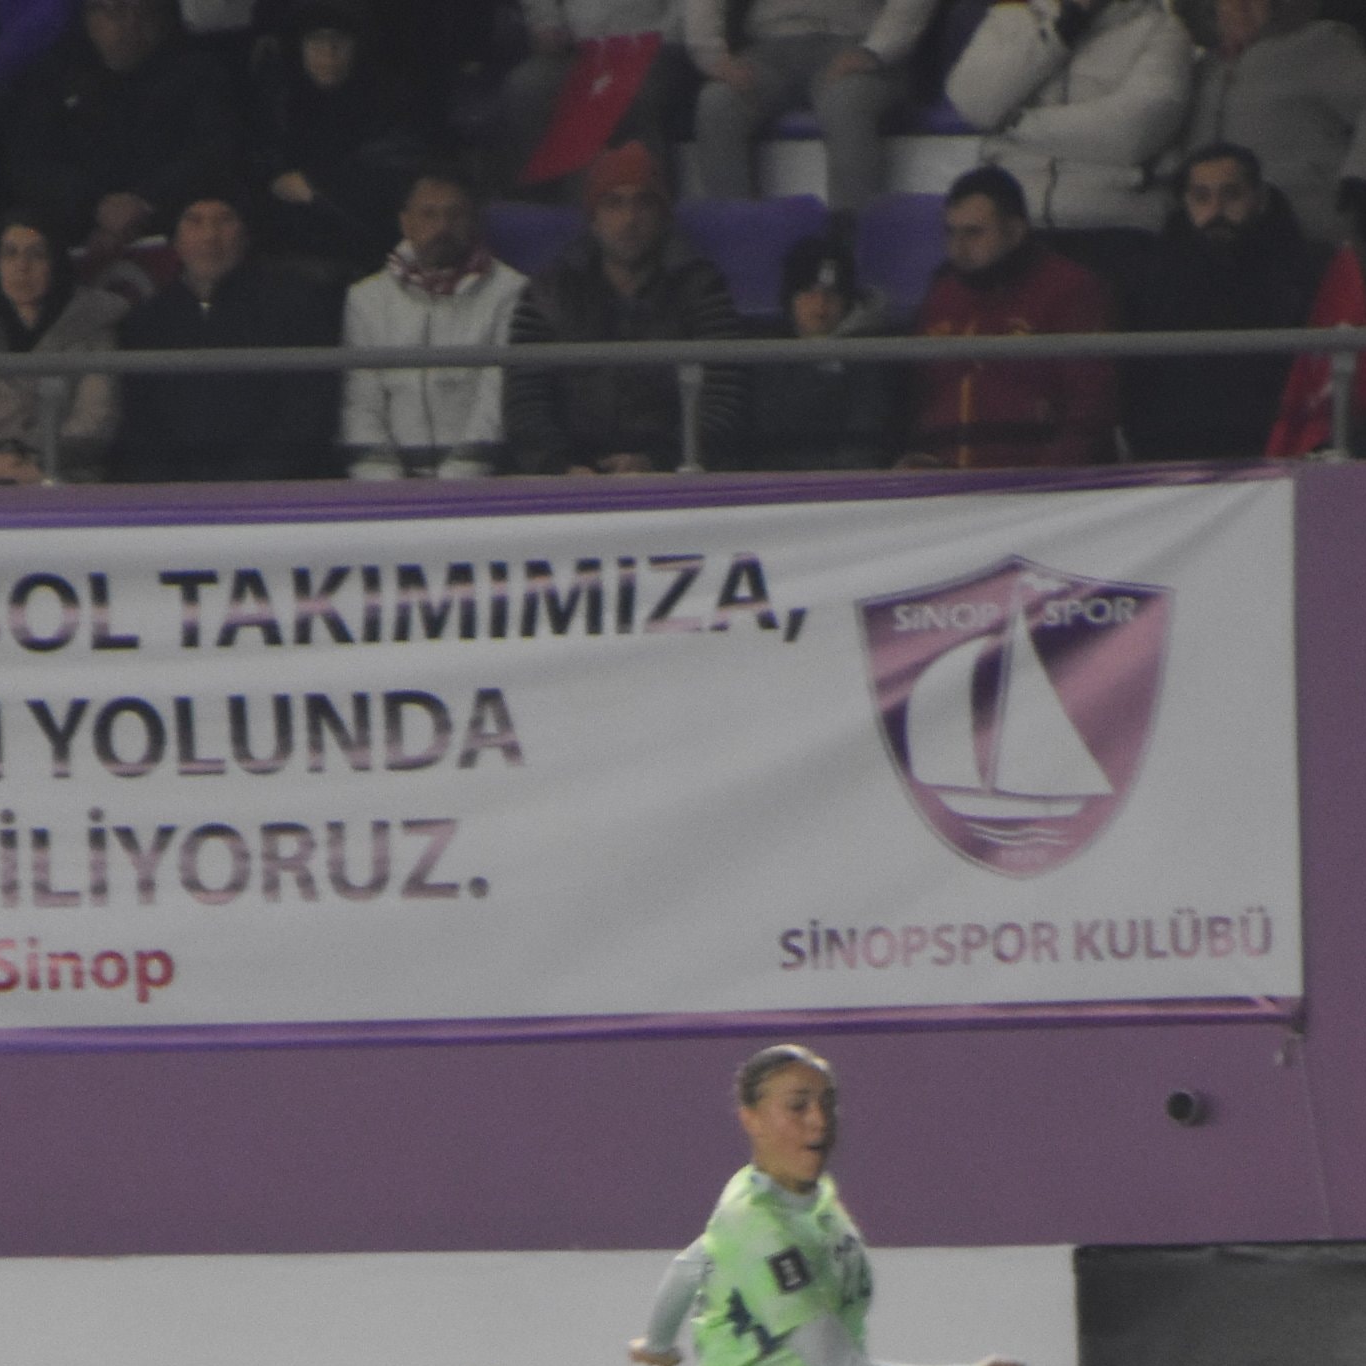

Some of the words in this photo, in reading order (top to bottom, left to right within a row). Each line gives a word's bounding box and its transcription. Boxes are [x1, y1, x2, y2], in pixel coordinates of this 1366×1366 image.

[26, 686, 525, 779] YOLUNDA
[778, 918, 1060, 971] SİNOPSPOR
[1073, 907, 1273, 962] KULÜBÜ
